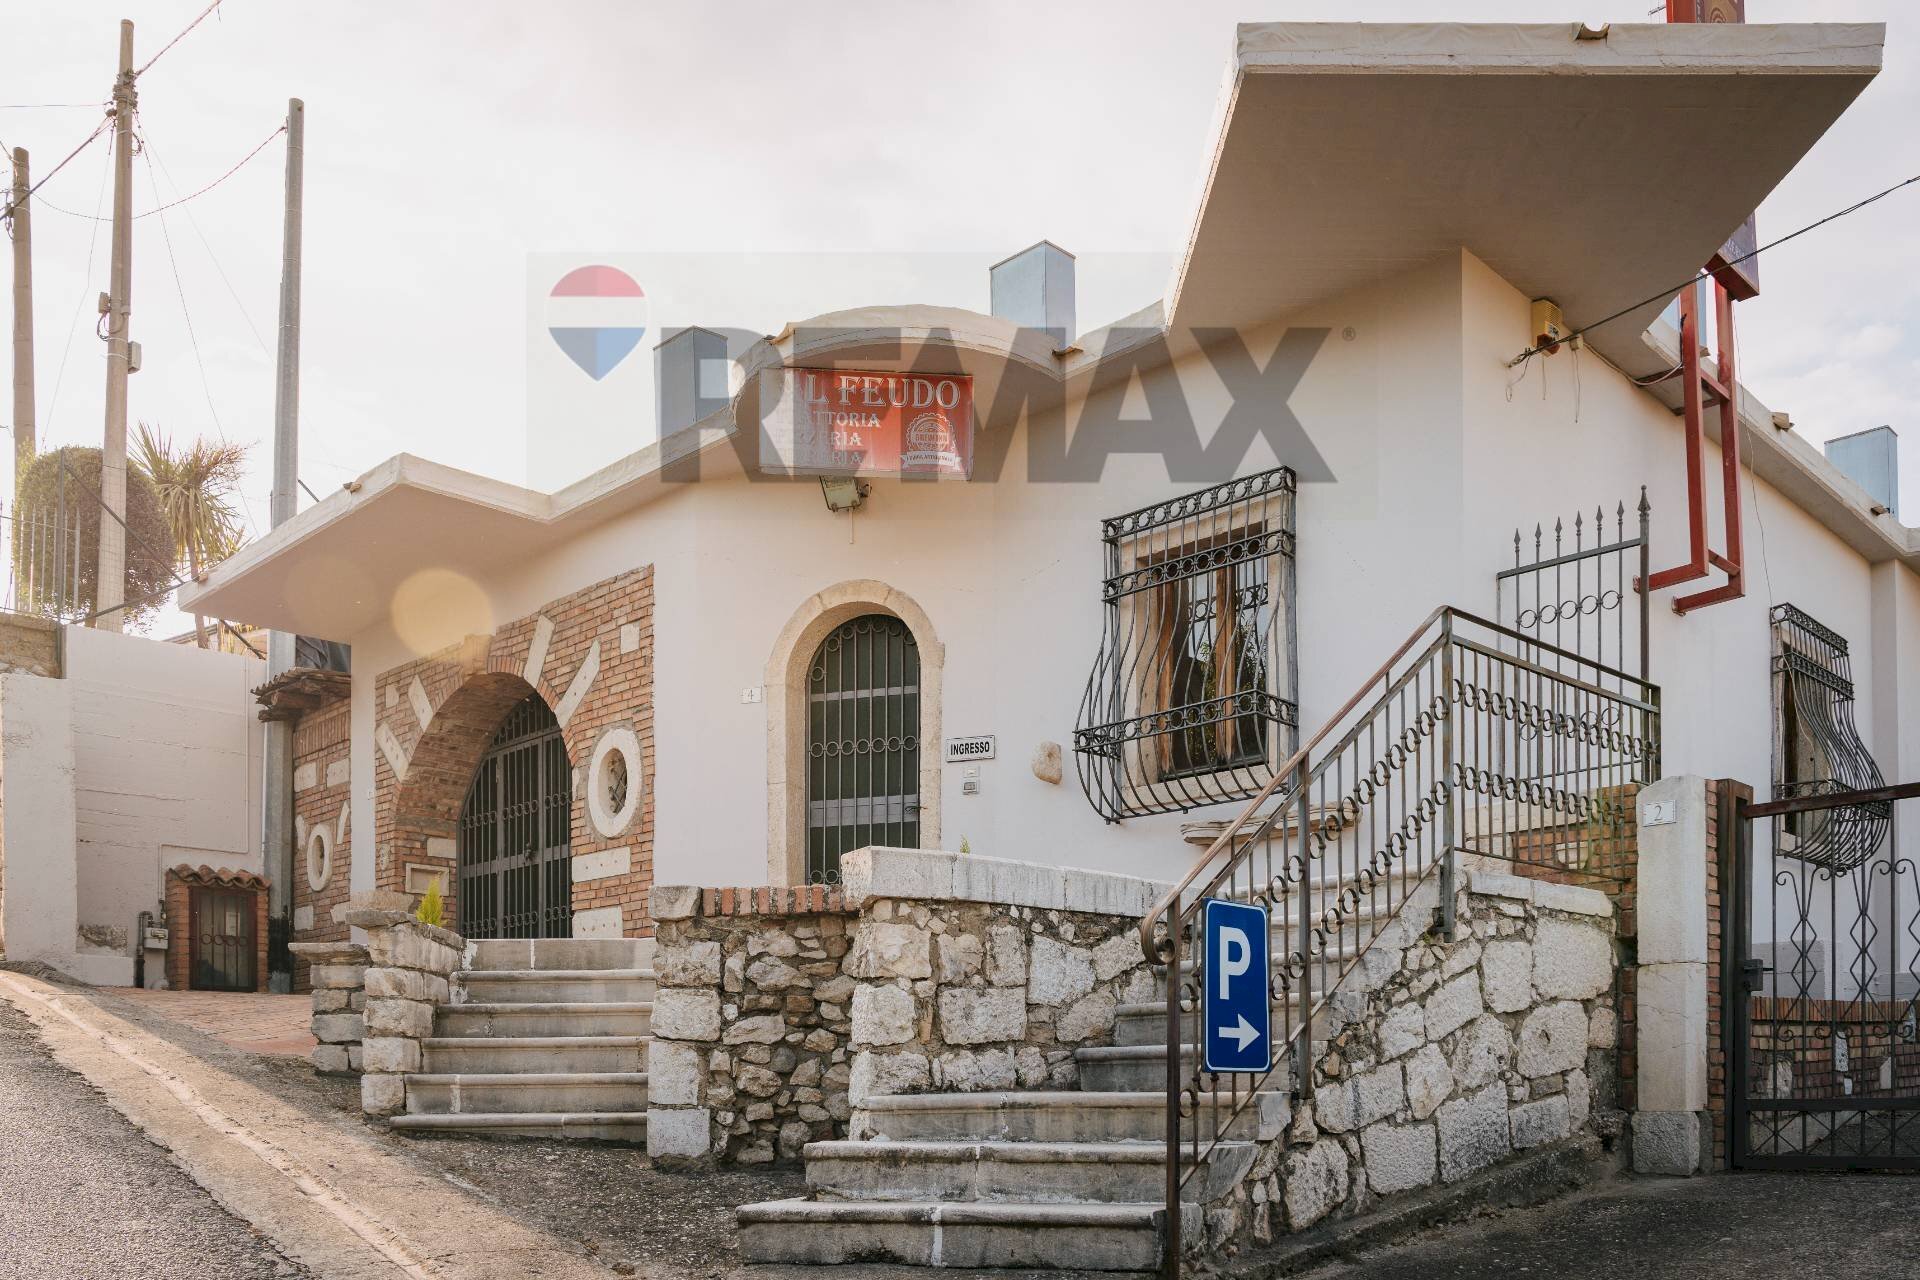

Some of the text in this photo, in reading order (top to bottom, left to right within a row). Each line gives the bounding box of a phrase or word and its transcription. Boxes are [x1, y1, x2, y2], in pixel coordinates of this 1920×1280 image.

[837, 376, 961, 409] FEUDO
[950, 741, 990, 756] INGRESSO
[1654, 805, 1663, 821] 2
[1219, 925, 1251, 1000] P
